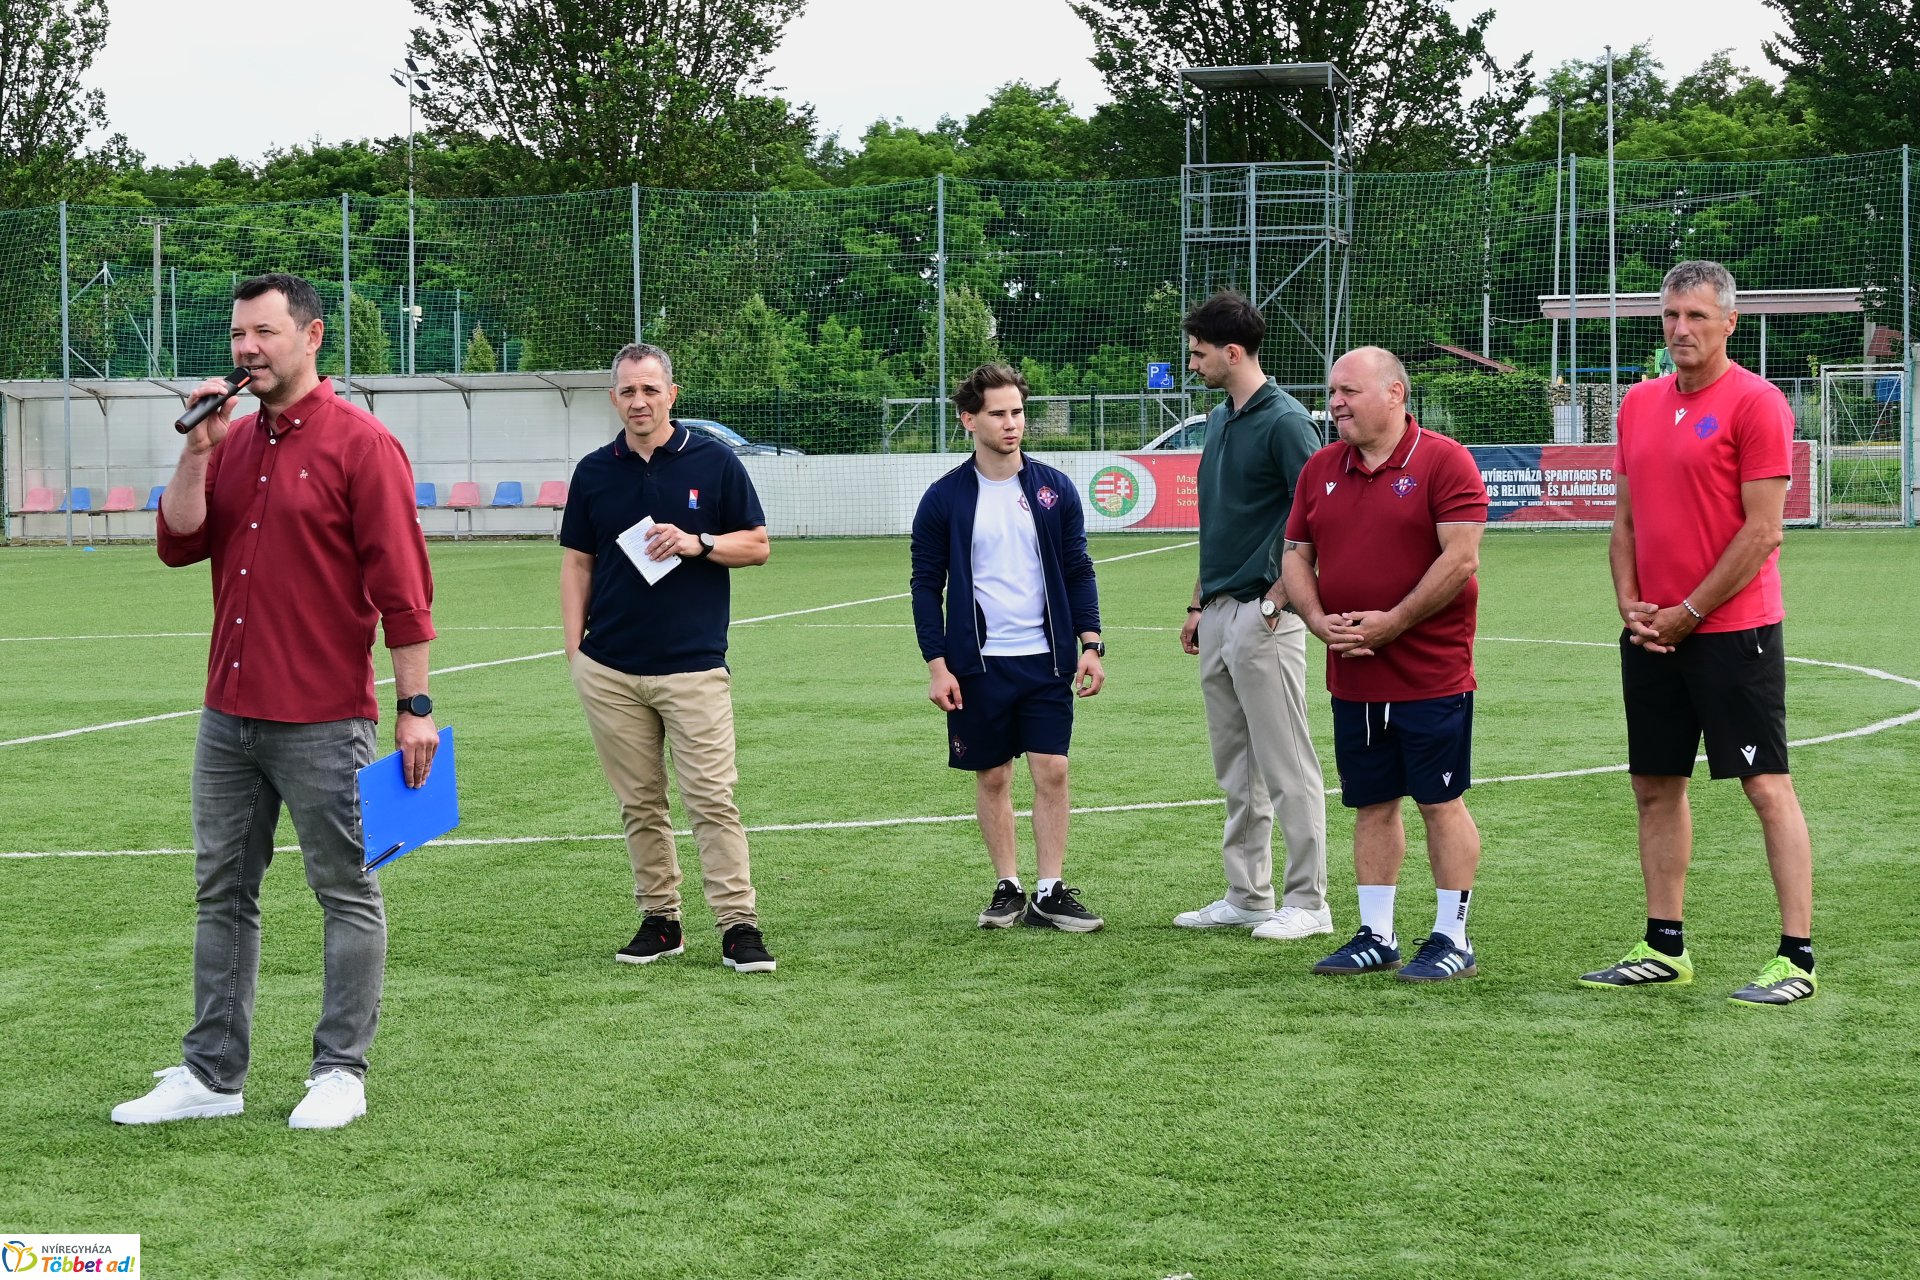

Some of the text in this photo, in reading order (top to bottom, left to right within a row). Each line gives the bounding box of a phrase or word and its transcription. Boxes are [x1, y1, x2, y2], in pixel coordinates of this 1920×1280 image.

[1150, 366, 1160, 378] P
[1176, 475, 1198, 485] Mag
[1481, 467, 1612, 482] NYÍREGYHÁZA SPARTACUS FC
[1176, 486, 1198, 495] Labd
[1486, 484, 1499, 497] OS
[1501, 484, 1545, 497] RELIKVIA-
[1547, 482, 1559, 497] ÉS
[1176, 497, 1197, 507] Szöv
[1457, 904, 1466, 921] NIKE
